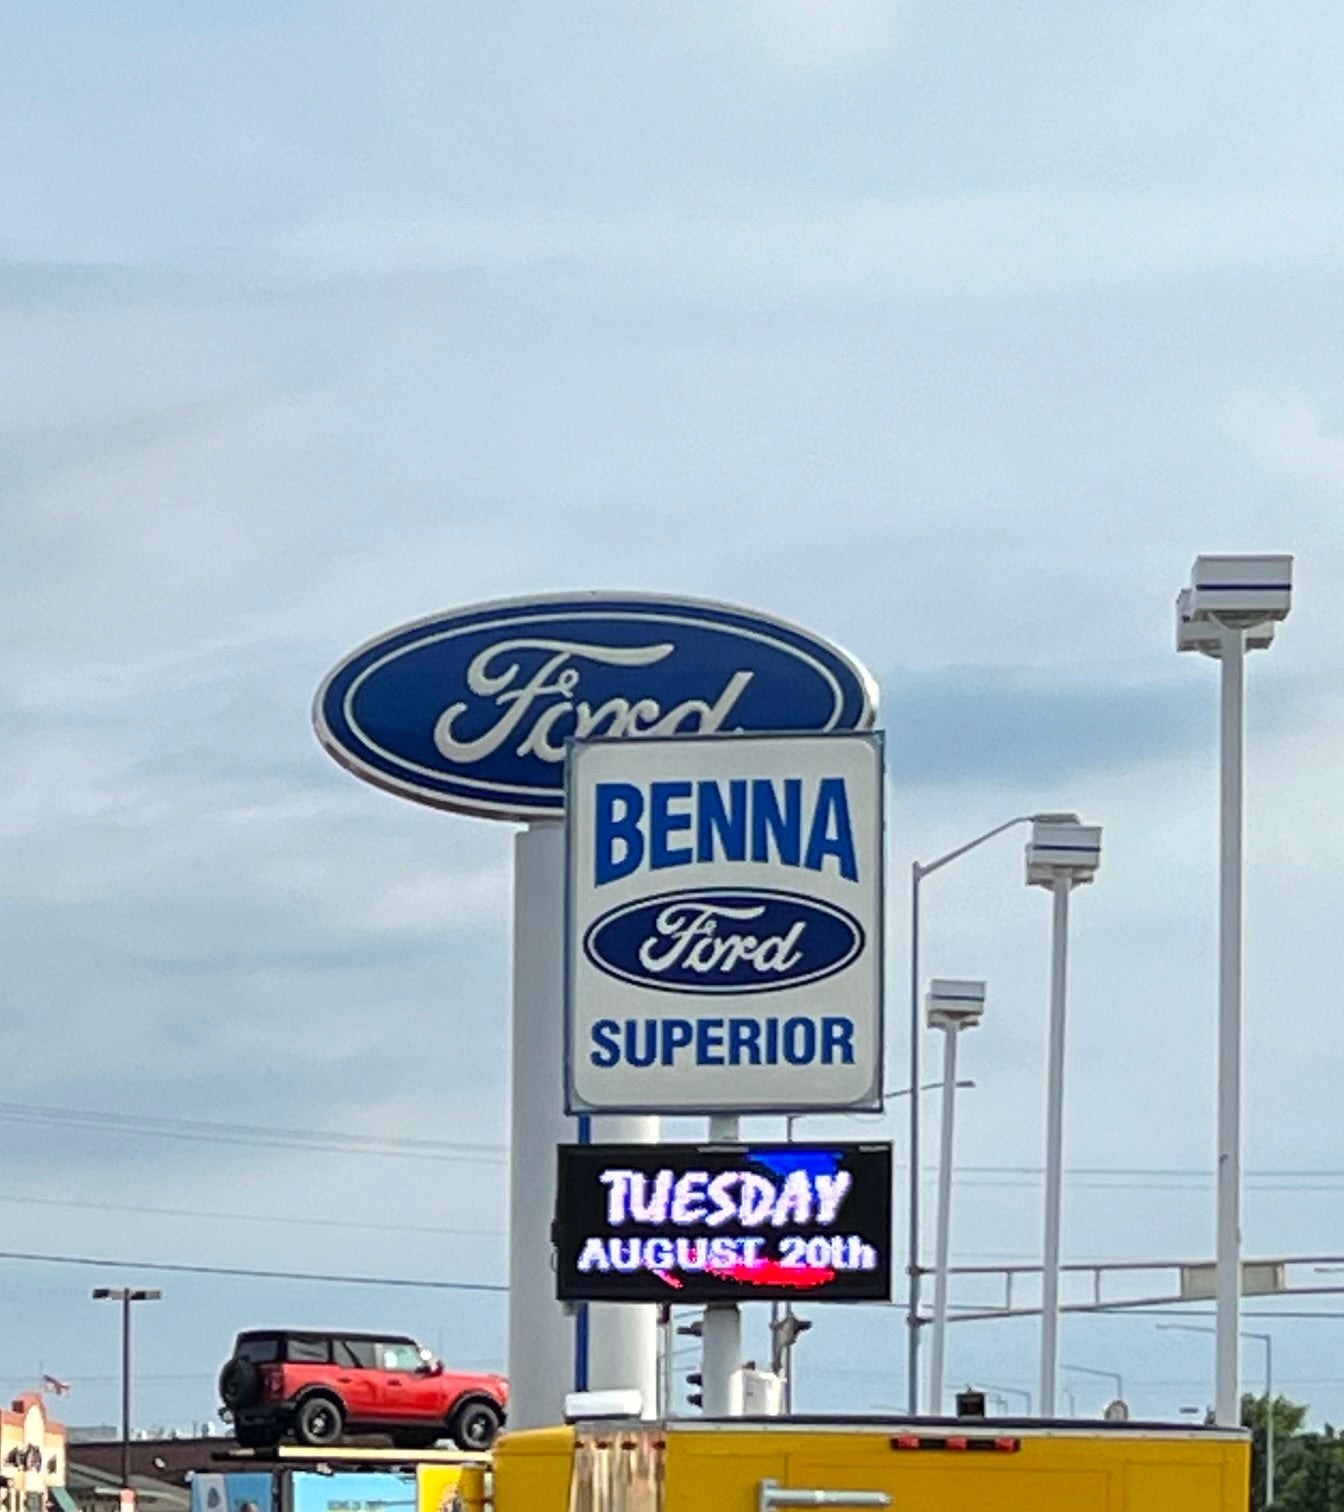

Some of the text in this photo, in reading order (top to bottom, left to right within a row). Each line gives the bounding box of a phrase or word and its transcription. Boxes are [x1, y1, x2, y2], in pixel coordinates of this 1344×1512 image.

[434, 638, 754, 763] Ford
[595, 778, 859, 888] BENNA
[639, 903, 807, 972] Ford
[591, 1016, 855, 1068] SUPERIOR
[600, 1168, 852, 1227] TUESDAY
[577, 1234, 878, 1273] AUGUST 20th
